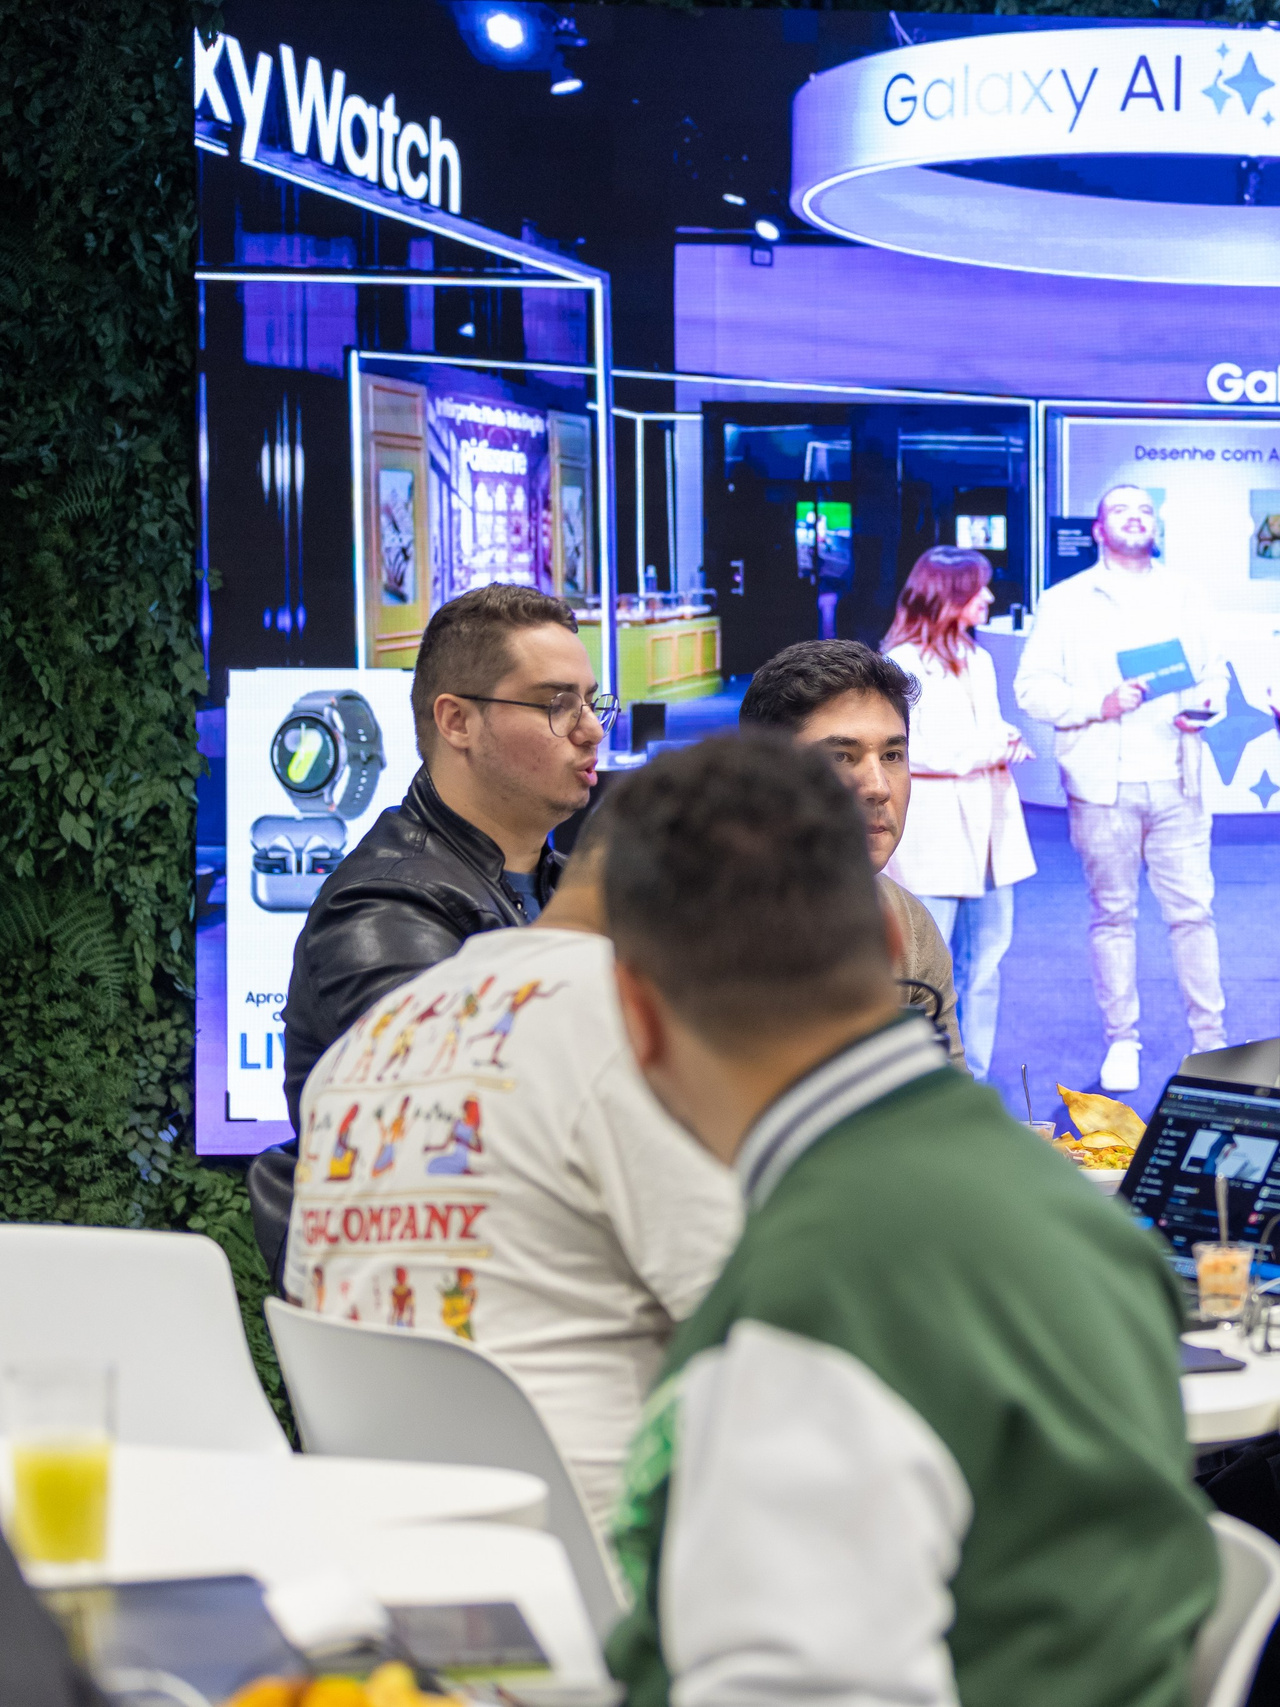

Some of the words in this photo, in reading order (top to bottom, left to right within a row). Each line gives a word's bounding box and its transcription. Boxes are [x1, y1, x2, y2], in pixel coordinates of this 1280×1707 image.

[279, 43, 461, 214] Watch
[884, 64, 1098, 133] Galaxy
[1120, 54, 1182, 112] AI
[1134, 444, 1215, 461] Desenhe
[1221, 449, 1263, 462] com
